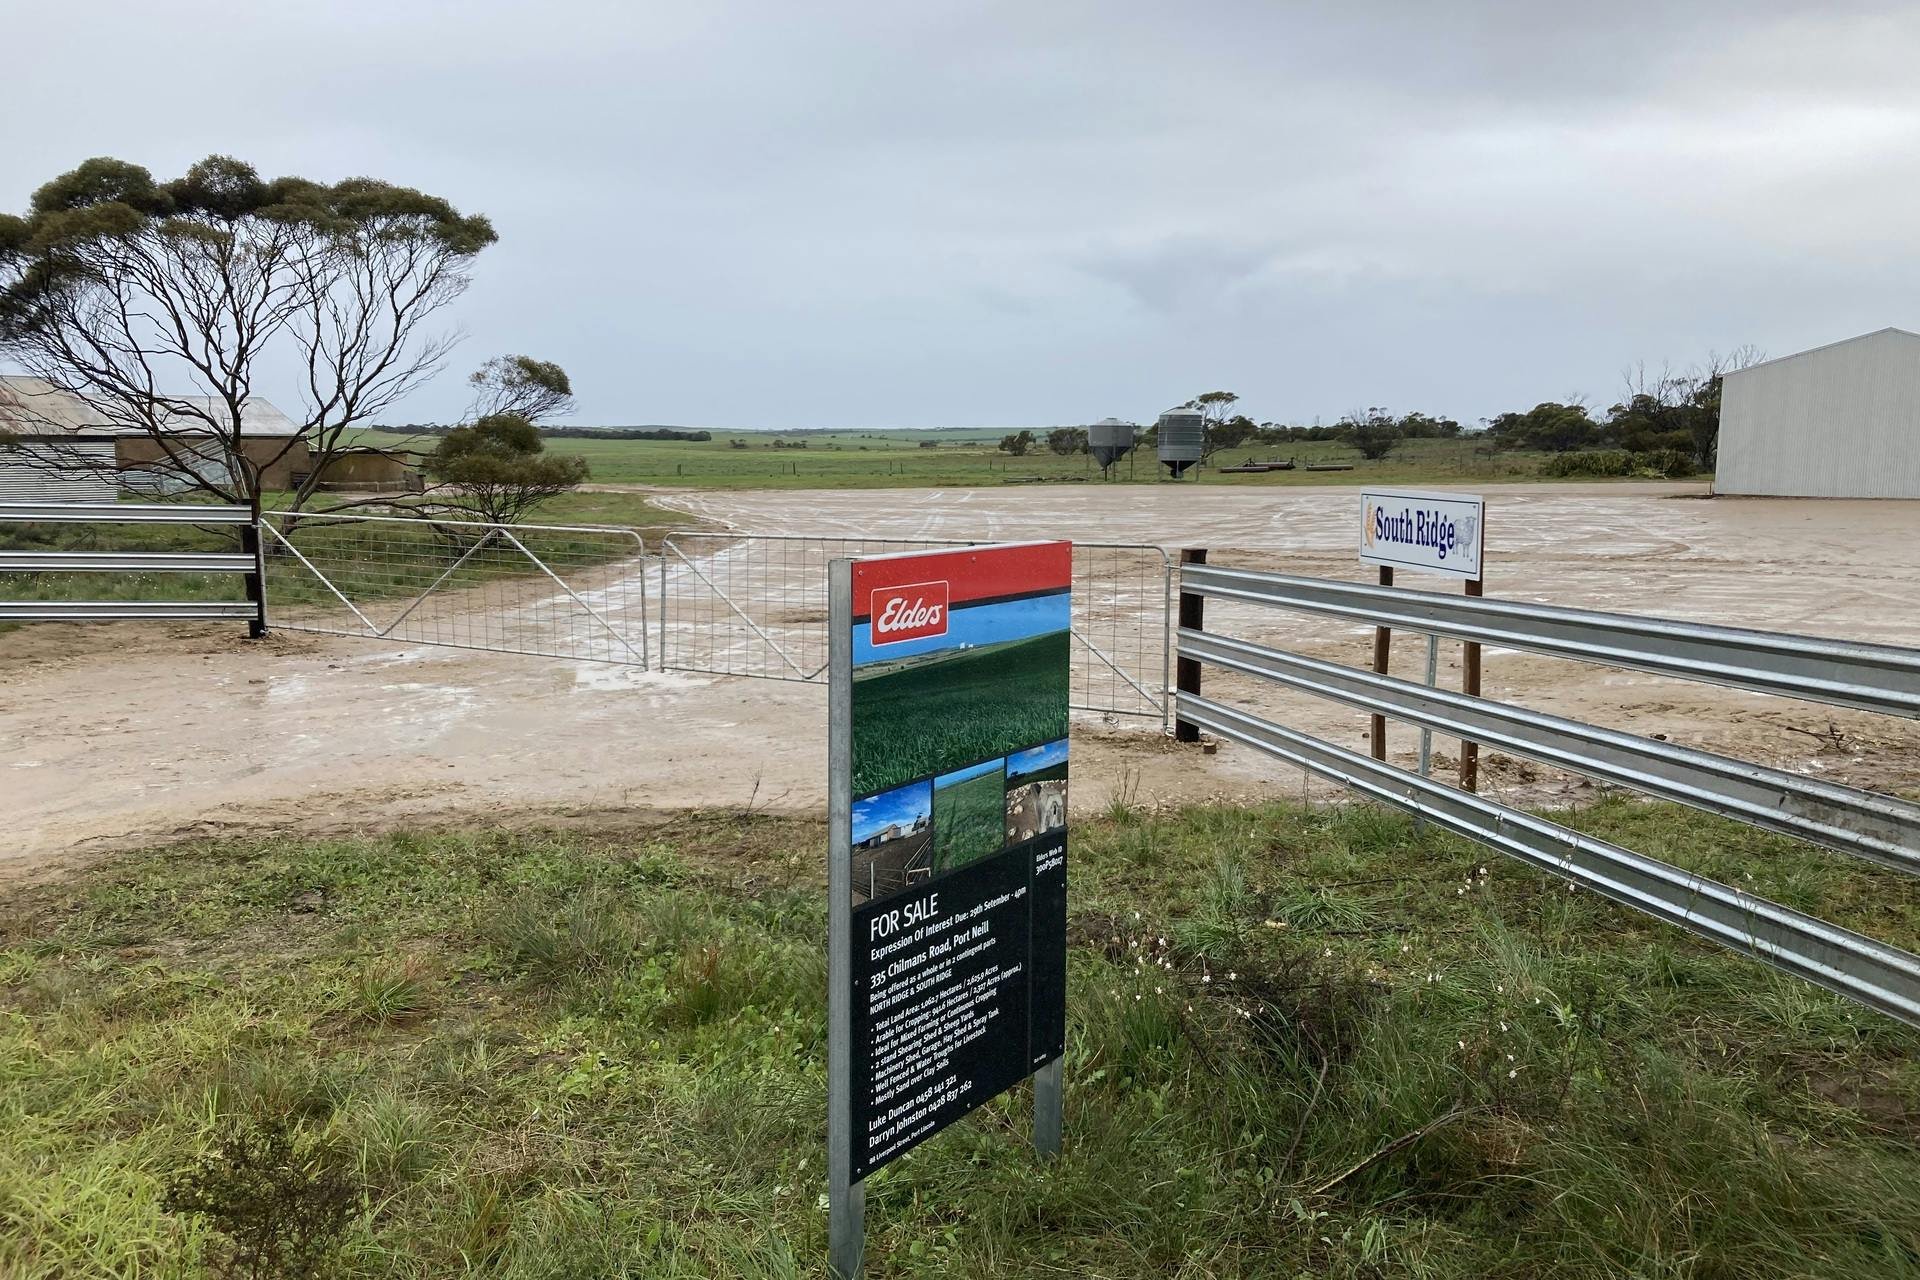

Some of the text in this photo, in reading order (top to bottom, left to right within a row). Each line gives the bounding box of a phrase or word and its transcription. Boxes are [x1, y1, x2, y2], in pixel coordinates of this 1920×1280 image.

[1376, 506, 1454, 559] South Ridge
[878, 598, 943, 633] Elders
[871, 892, 938, 942] FOR SALE
[871, 936, 912, 960] Expression
[914, 927, 924, 941] Of
[926, 916, 953, 937] Interest
[955, 912, 968, 923] Due:
[970, 904, 983, 918] 29th
[1014, 886, 1026, 898] 4pm
[870, 920, 989, 989] 335 Chilmans Road, Port Neill
[870, 989, 886, 1003] Being
[888, 977, 908, 993] offered
[909, 976, 916, 984] as
[922, 964, 938, 977] whole
[946, 958, 951, 966] in
[956, 943, 982, 961] contingent
[983, 938, 996, 950] parts
[870, 968, 952, 1015] NORTH RIDGE & SOUTH RIDGE
[875, 1042, 890, 1056] Ideal
[890, 1039, 899, 1048] for
[900, 1027, 917, 1043] Mixed
[918, 1018, 939, 1034] Farming
[947, 1000, 975, 1018] Continuous
[975, 987, 997, 1003] Cropping
[876, 1017, 890, 1031] Total
[891, 1010, 904, 1024] Land
[905, 1005, 920, 1017] Area:
[940, 983, 962, 999] Hectares
[985, 965, 999, 976] Acres
[876, 1029, 894, 1044] Arable
[896, 1024, 904, 1033] for
[947, 991, 968, 1007] Hectares
[987, 975, 1000, 987] Acres
[875, 1060, 904, 1080] Machinery
[922, 1041, 943, 1055] Garage,
[943, 1033, 953, 1044] Hay
[954, 1024, 967, 1038] Shed
[968, 1022, 972, 1030] &
[973, 1014, 988, 1028] Spray
[988, 1007, 999, 1019] Tank
[875, 1079, 888, 1092] Well
[890, 1067, 909, 1085] Fenced
[910, 1065, 915, 1074] &
[916, 1056, 932, 1070] Water
[933, 1044, 954, 1060] Troughs
[963, 1025, 986, 1044] Livestock
[881, 1050, 897, 1066] stand
[898, 1038, 922, 1056] Shearing
[923, 1028, 937, 1043] Shed
[938, 1027, 943, 1035] &
[944, 1019, 960, 1032] Sheep
[960, 1010, 974, 1022] Yards
[869, 1073, 957, 1132] Luke Duncan 0458 141 321
[869, 1079, 972, 1148] Darryn Johnston 0428 837 262
[875, 1058, 949, 1105] Mostly Sand over Clay Soils
[876, 1143, 896, 1161] Liverpool
[911, 1129, 920, 1138] Port
